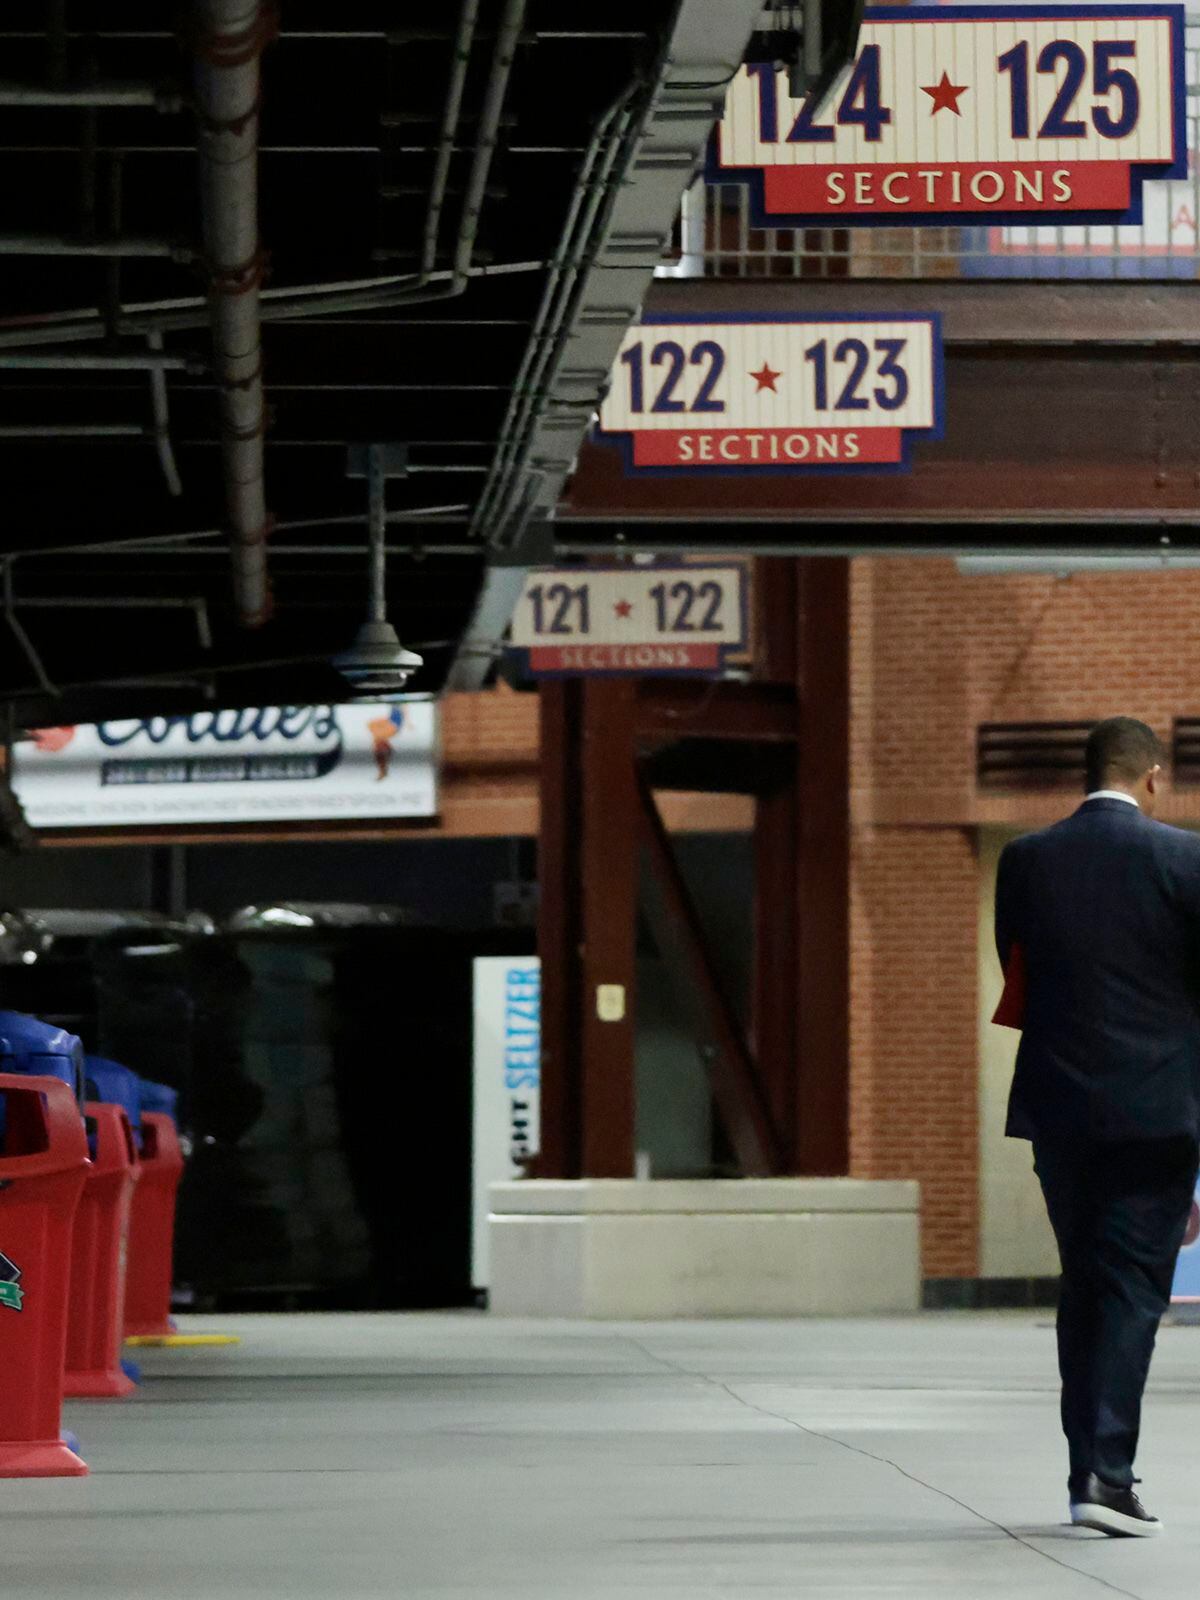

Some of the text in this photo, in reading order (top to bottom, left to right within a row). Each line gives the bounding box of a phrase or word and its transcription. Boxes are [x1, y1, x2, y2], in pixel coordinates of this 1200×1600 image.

[996, 39, 1140, 140] 125
[826, 169, 1073, 205] SECTIONS
[620, 338, 910, 413] 122 123
[679, 434, 860, 460] SECTIONS
[528, 580, 724, 634] 121 122
[559, 648, 692, 668] SECTIONS
[505, 967, 541, 1090] SELTZER
